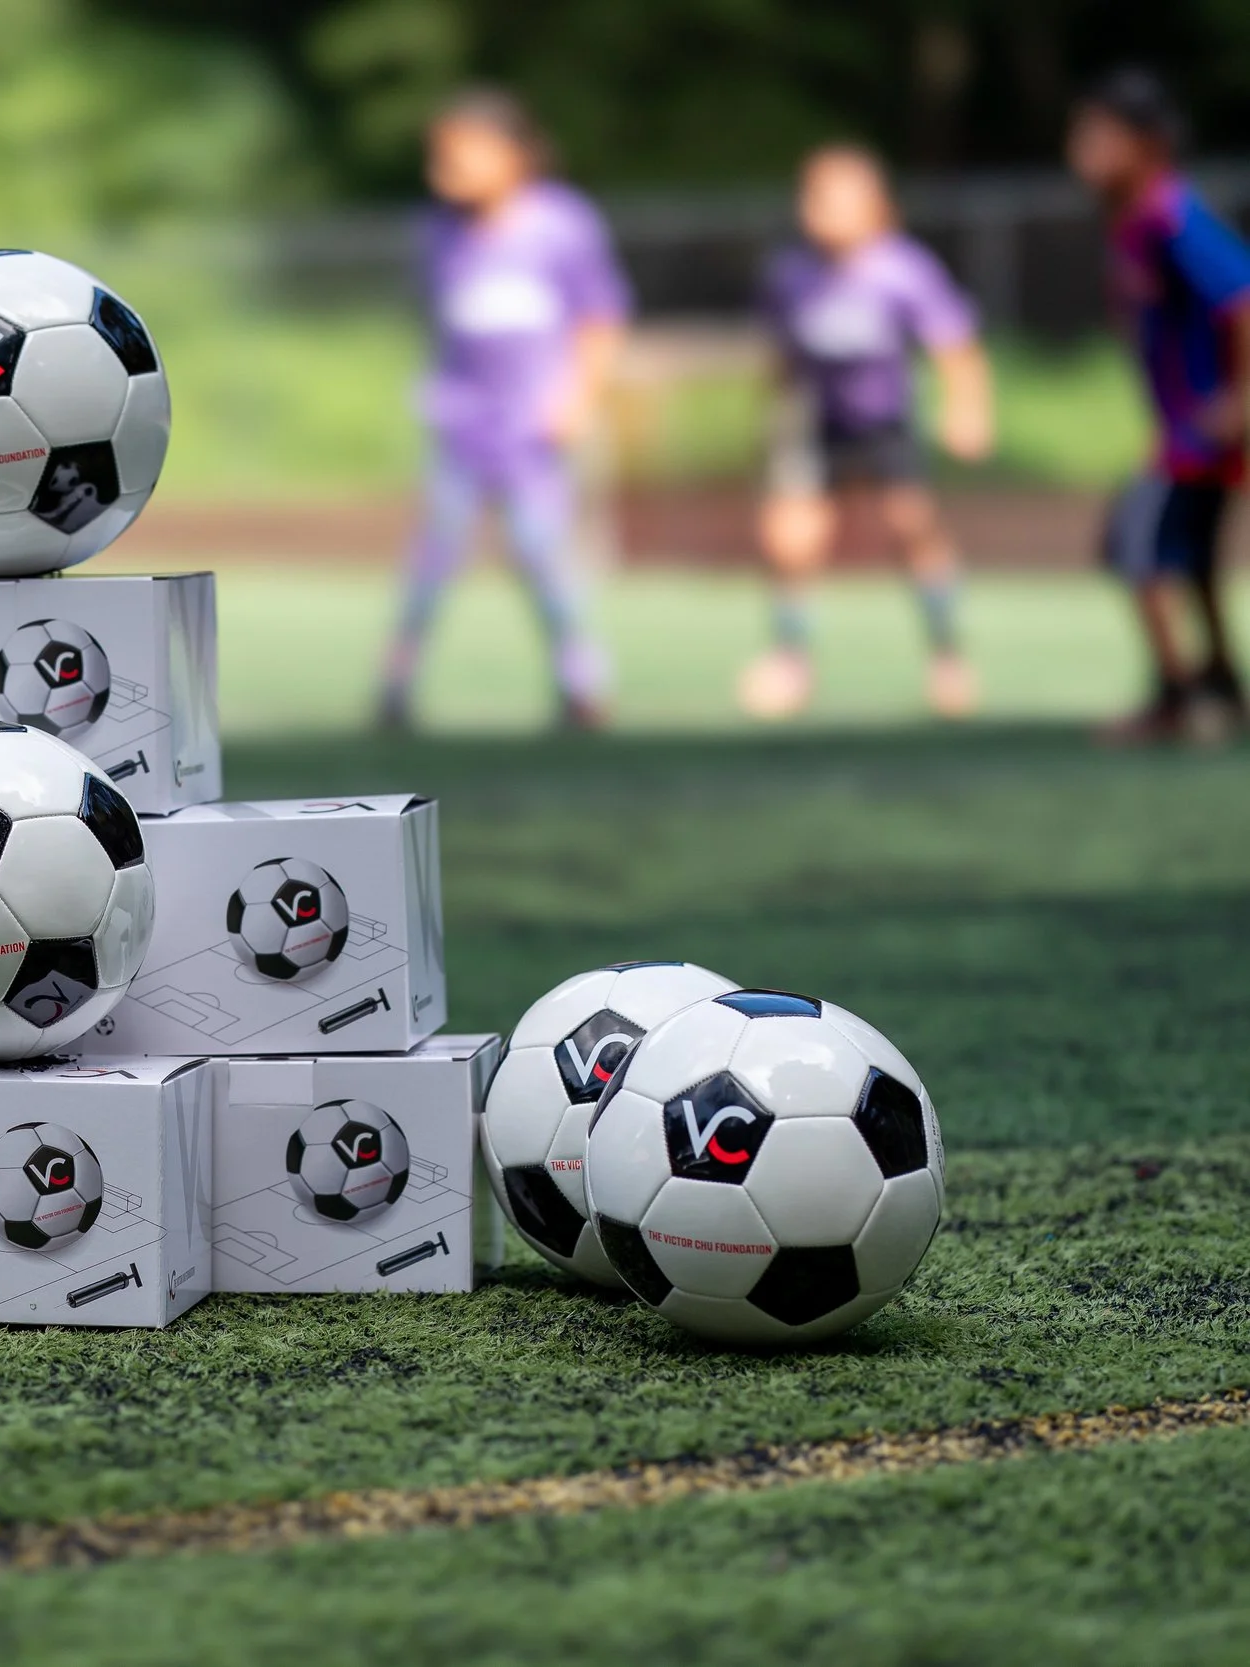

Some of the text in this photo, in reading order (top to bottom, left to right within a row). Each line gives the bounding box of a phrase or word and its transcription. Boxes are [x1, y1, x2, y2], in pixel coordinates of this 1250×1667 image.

[39, 651, 78, 683] VC
[276, 890, 317, 921] VC
[336, 1132, 378, 1163] VC
[681, 1099, 757, 1165] VC
[29, 1157, 70, 1189] VC
[551, 1161, 566, 1171] THE
[648, 1230, 772, 1255] THE VICTOR CHU FOUNDATION
